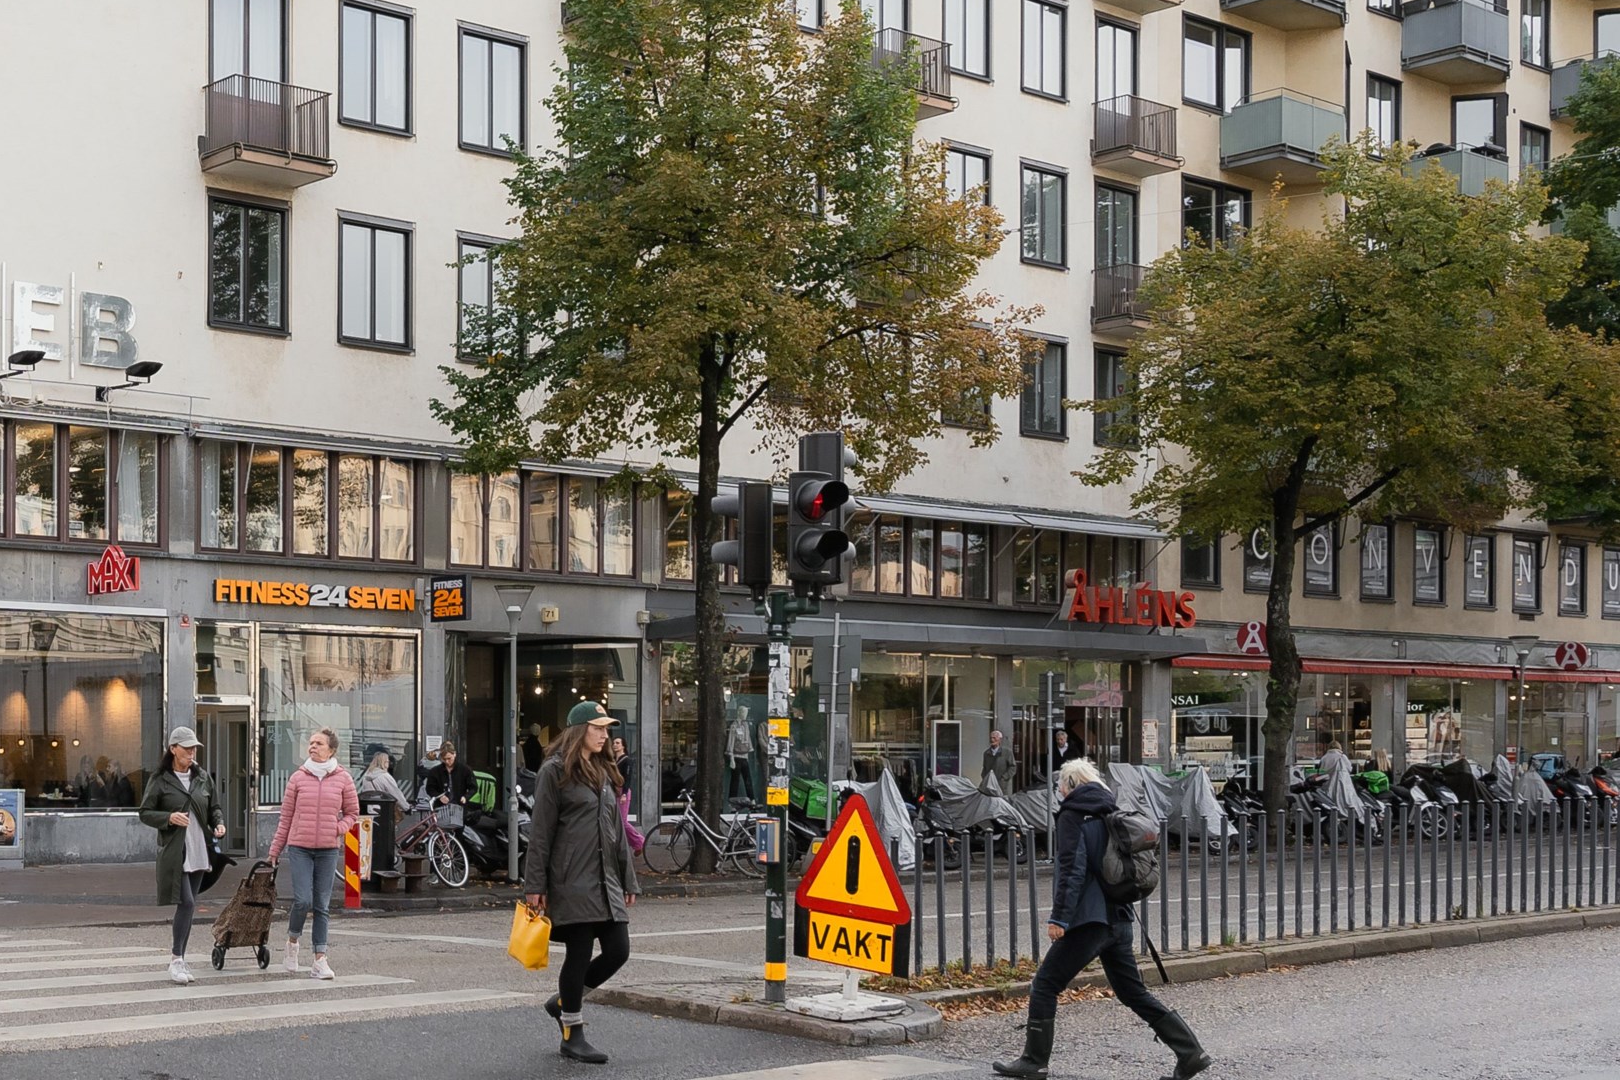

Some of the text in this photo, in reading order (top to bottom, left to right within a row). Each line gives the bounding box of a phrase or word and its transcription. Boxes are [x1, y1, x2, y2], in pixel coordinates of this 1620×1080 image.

[87, 545, 137, 595] MAX
[433, 579, 464, 591] FITNESS
[434, 589, 463, 607] 24
[1065, 568, 1196, 628] ÅHLÉNS
[433, 606, 464, 618] SEVEN
[545, 610, 555, 618] 71
[812, 921, 892, 962] VAKT
